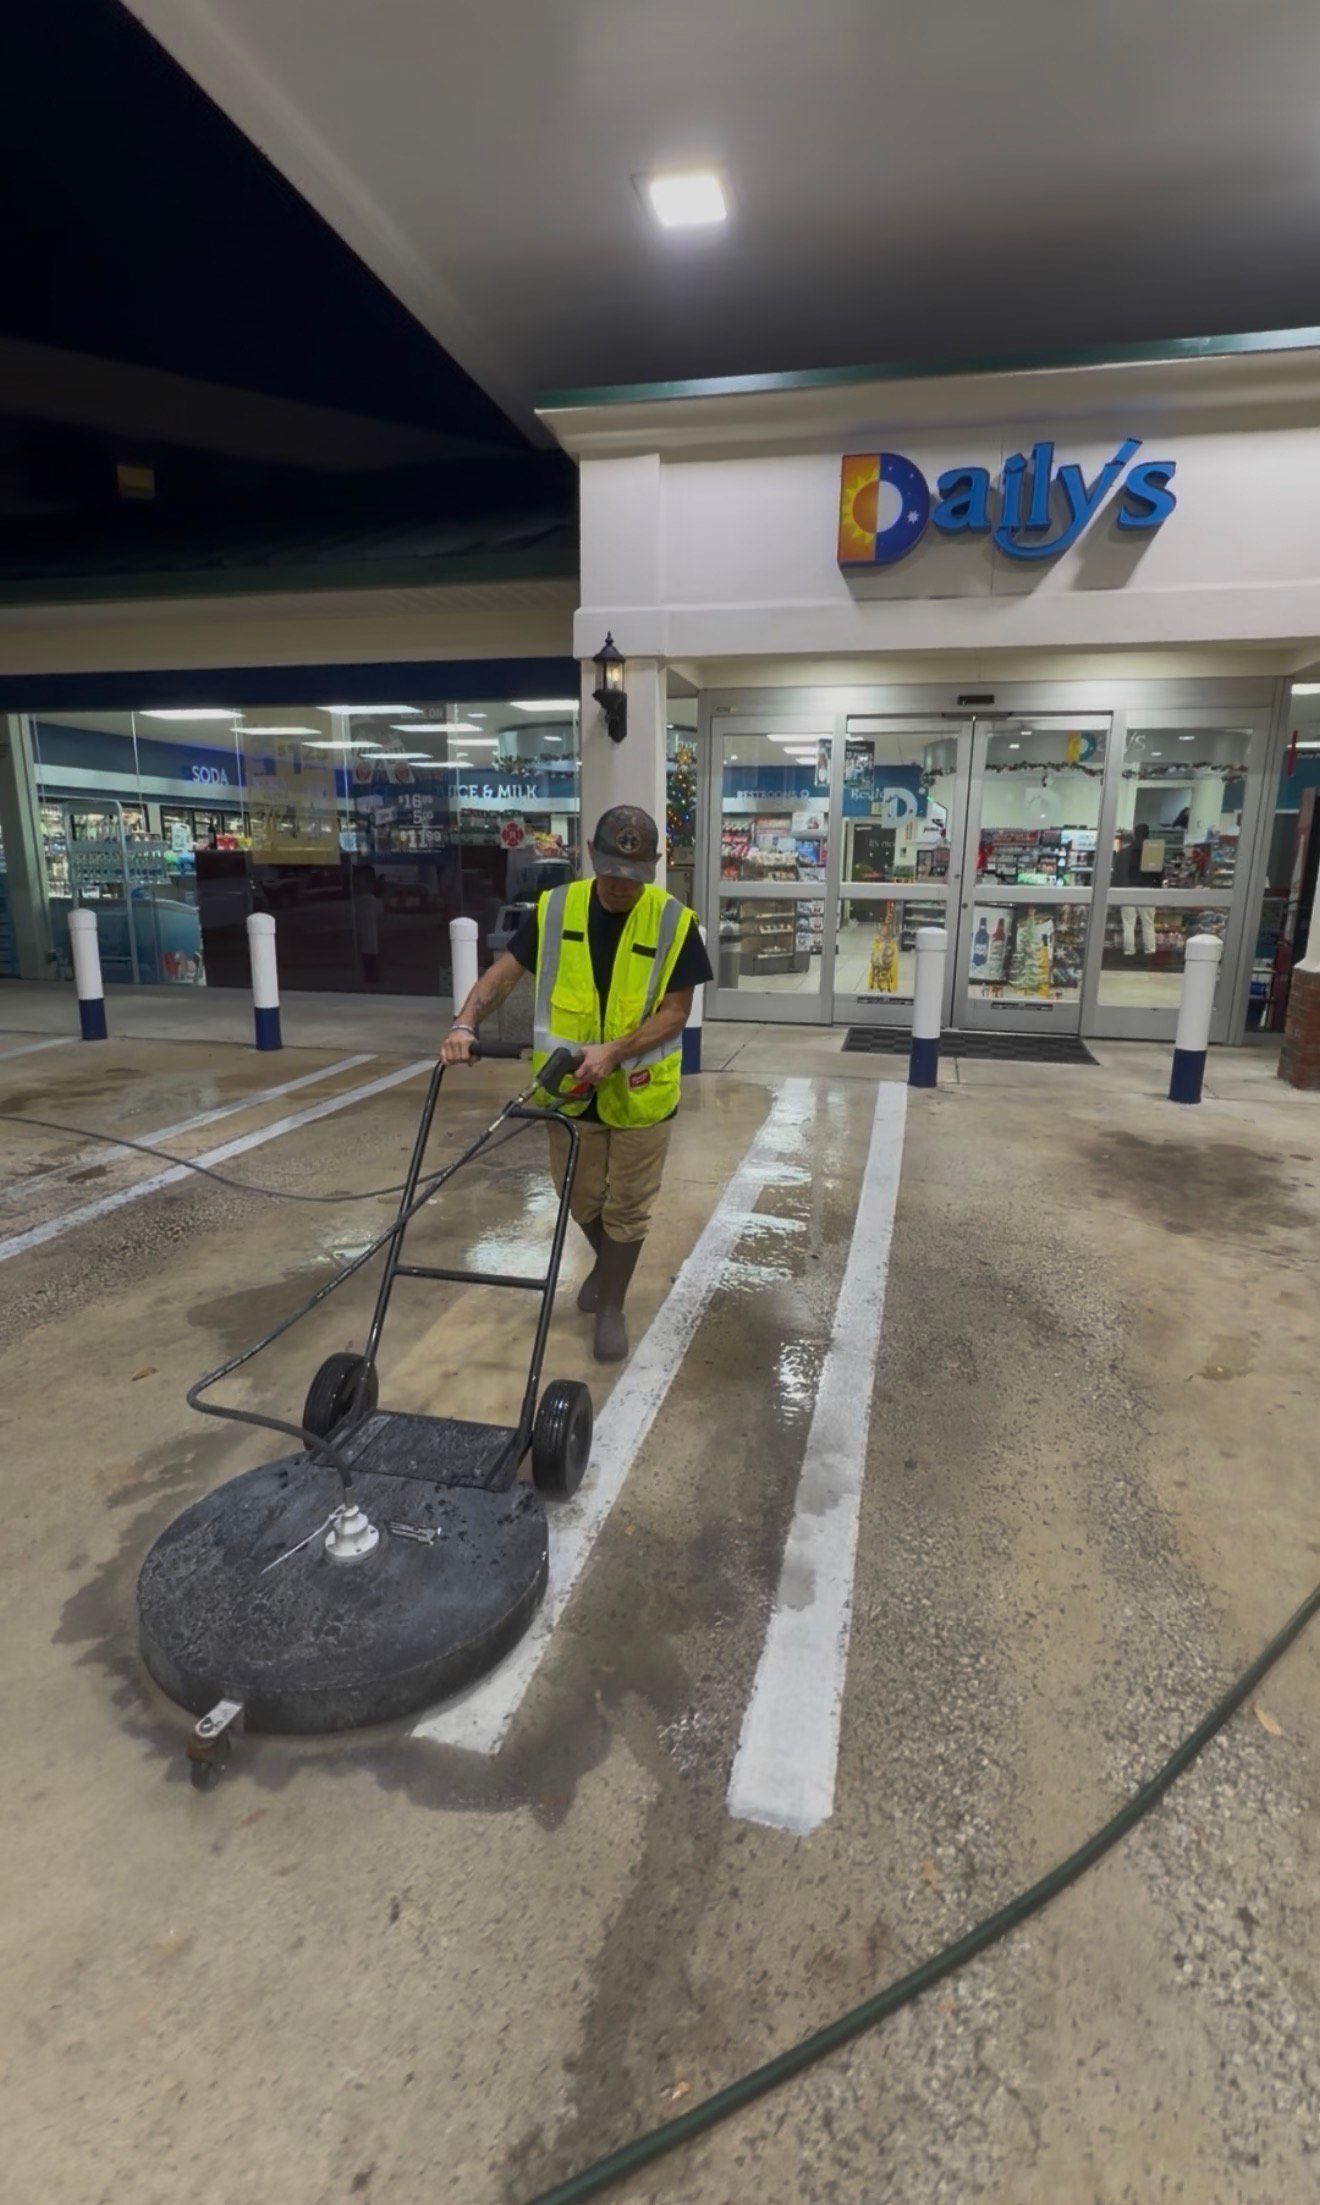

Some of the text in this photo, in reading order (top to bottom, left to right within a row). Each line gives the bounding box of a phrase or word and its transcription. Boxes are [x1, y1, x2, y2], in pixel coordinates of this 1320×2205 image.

[837, 437, 1177, 569] Daily's
[192, 765, 230, 785] SODA
[482, 784, 494, 799] &
[497, 784, 537, 800] MILK
